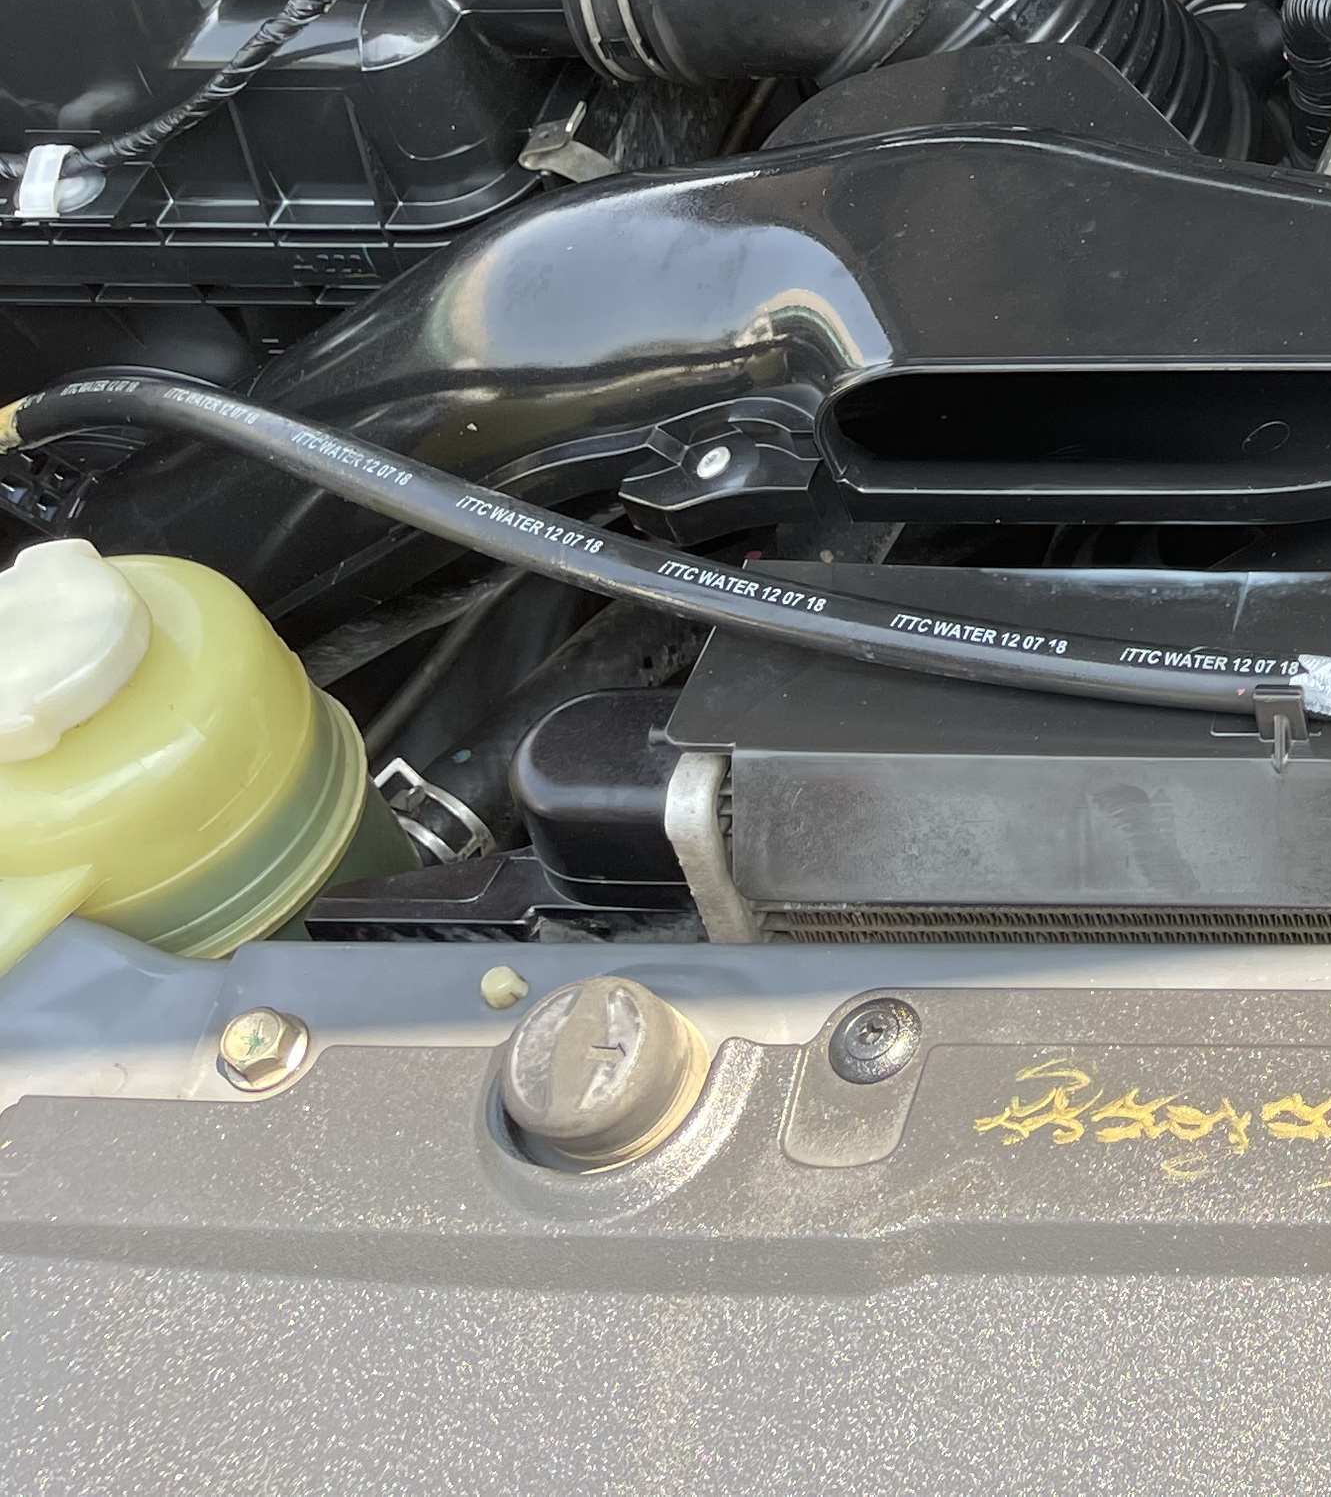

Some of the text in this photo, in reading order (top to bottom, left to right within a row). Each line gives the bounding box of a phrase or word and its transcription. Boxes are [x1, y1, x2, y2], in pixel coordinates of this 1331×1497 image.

[185, 392, 222, 412] WATER
[219, 403, 235, 416] 12
[229, 407, 248, 420] 07
[244, 411, 260, 425] 18
[320, 440, 364, 468] WATER
[362, 458, 380, 473] 12
[376, 464, 397, 479] 07
[394, 471, 413, 486] 18
[489, 506, 544, 535] WATER
[544, 525, 564, 542] 12
[562, 532, 584, 547] 07
[584, 538, 604, 554] 18
[698, 570, 760, 597] WATER
[762, 586, 782, 602] 12
[782, 591, 805, 607] 07
[806, 596, 827, 612] 18
[933, 621, 997, 644] WATER
[1001, 632, 1021, 648] 12
[1022, 635, 1045, 651] 07
[1048, 639, 1068, 654] 18
[1164, 653, 1228, 671] WATER
[1233, 658, 1252, 673] 12
[1255, 659, 1276, 674] 07
[1280, 661, 1299, 675] 18
